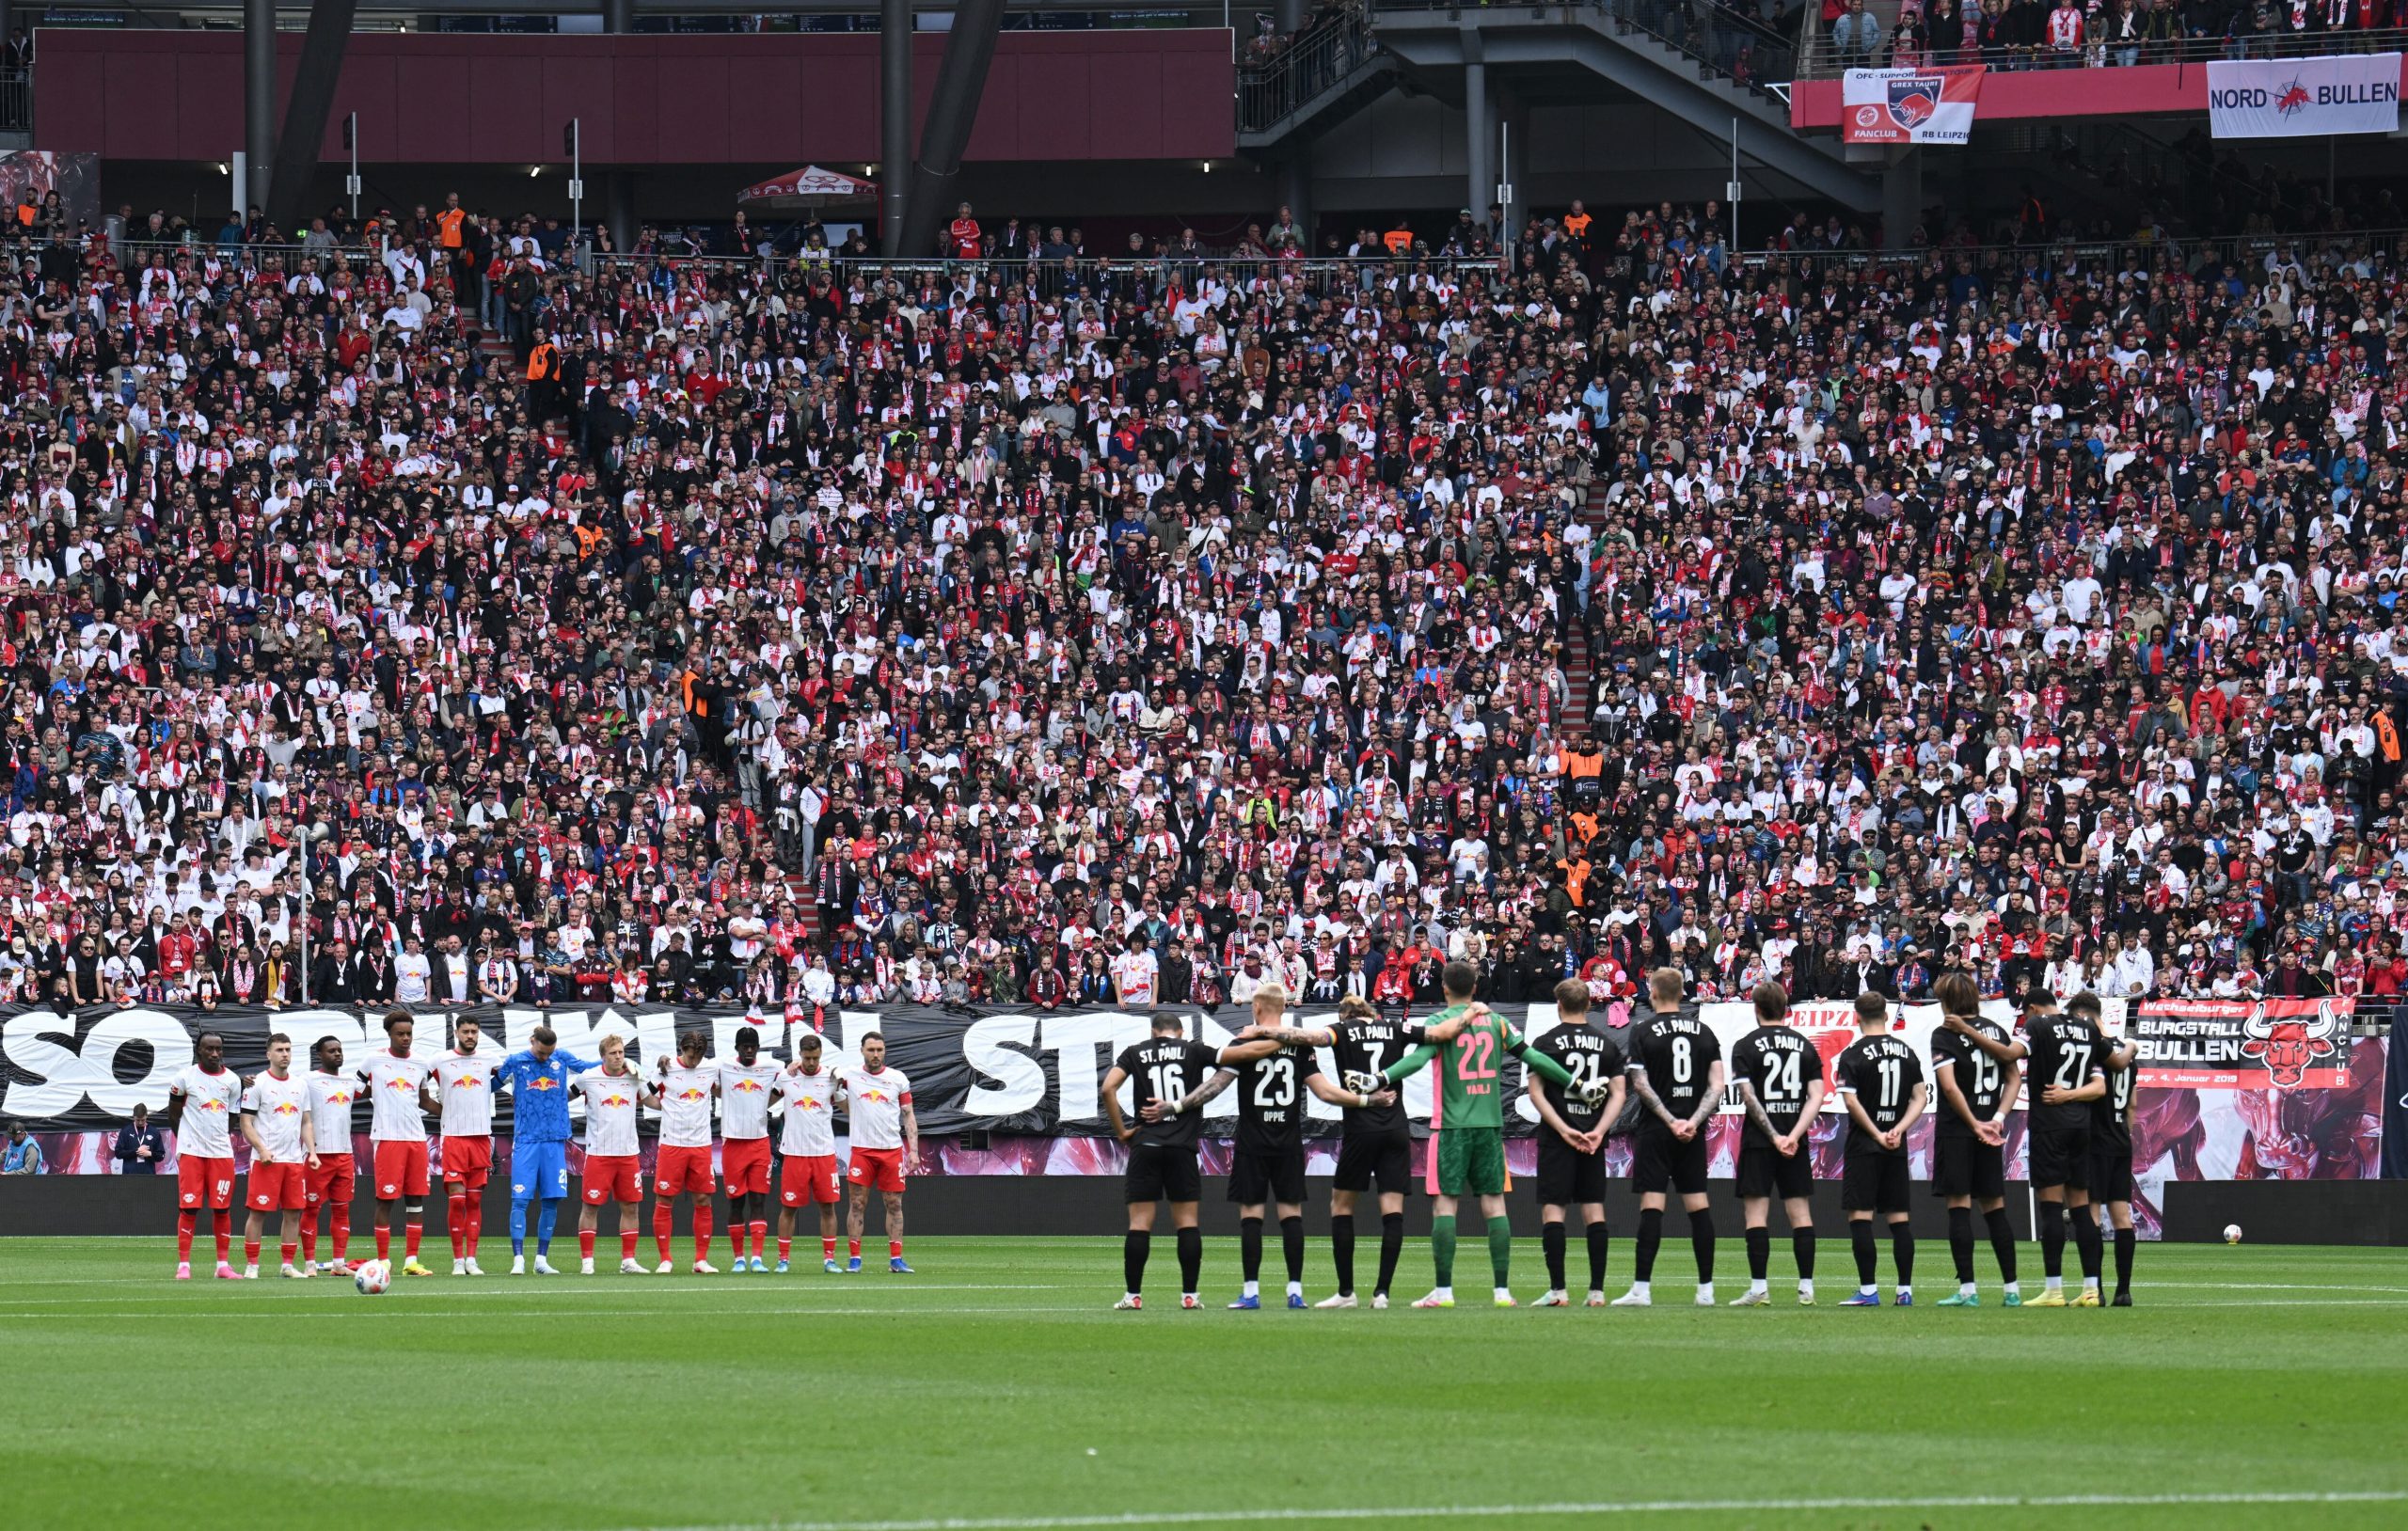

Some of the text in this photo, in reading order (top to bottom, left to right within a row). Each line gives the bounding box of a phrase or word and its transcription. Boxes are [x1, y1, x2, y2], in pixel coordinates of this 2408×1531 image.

[2211, 89, 2267, 109] NORD
[2318, 82, 2398, 105] BULLEN
[1347, 1025, 1394, 1042] ST. PAULI
[1652, 1019, 1701, 1037] ST. PAULI
[2052, 1024, 2068, 1039] ST.
[2138, 1021, 2241, 1035] BURGSTALL
[1555, 1034, 1605, 1051] ST. PAULI
[1754, 1035, 1804, 1052] ST. PAULI
[1862, 1041, 1909, 1061] ST. PAULI
[2135, 1039, 2239, 1061] BULLEN
[2336, 999, 2350, 1086] FANCLUB
[2, 1009, 195, 1117] SO
[1138, 1046, 1187, 1064] ST. PAULI
[1362, 1042, 1385, 1075] 7
[1456, 1031, 1497, 1081] 22
[1671, 1035, 1692, 1083] 8
[2053, 1041, 2091, 1089] 27
[1563, 1051, 1600, 1098] 21
[1763, 1051, 1802, 1100] 24
[1971, 1048, 1999, 1094] 15
[2160, 1074, 2170, 1082] 4.
[2174, 1074, 2210, 1082] Januar
[1148, 1063, 1186, 1104] 16
[1254, 1058, 1295, 1107] 23
[1671, 1086, 1693, 1097] SMITH
[1877, 1058, 1900, 1107] 11
[1263, 1111, 1286, 1123] OPPIE
[217, 1179, 230, 1195] 49
